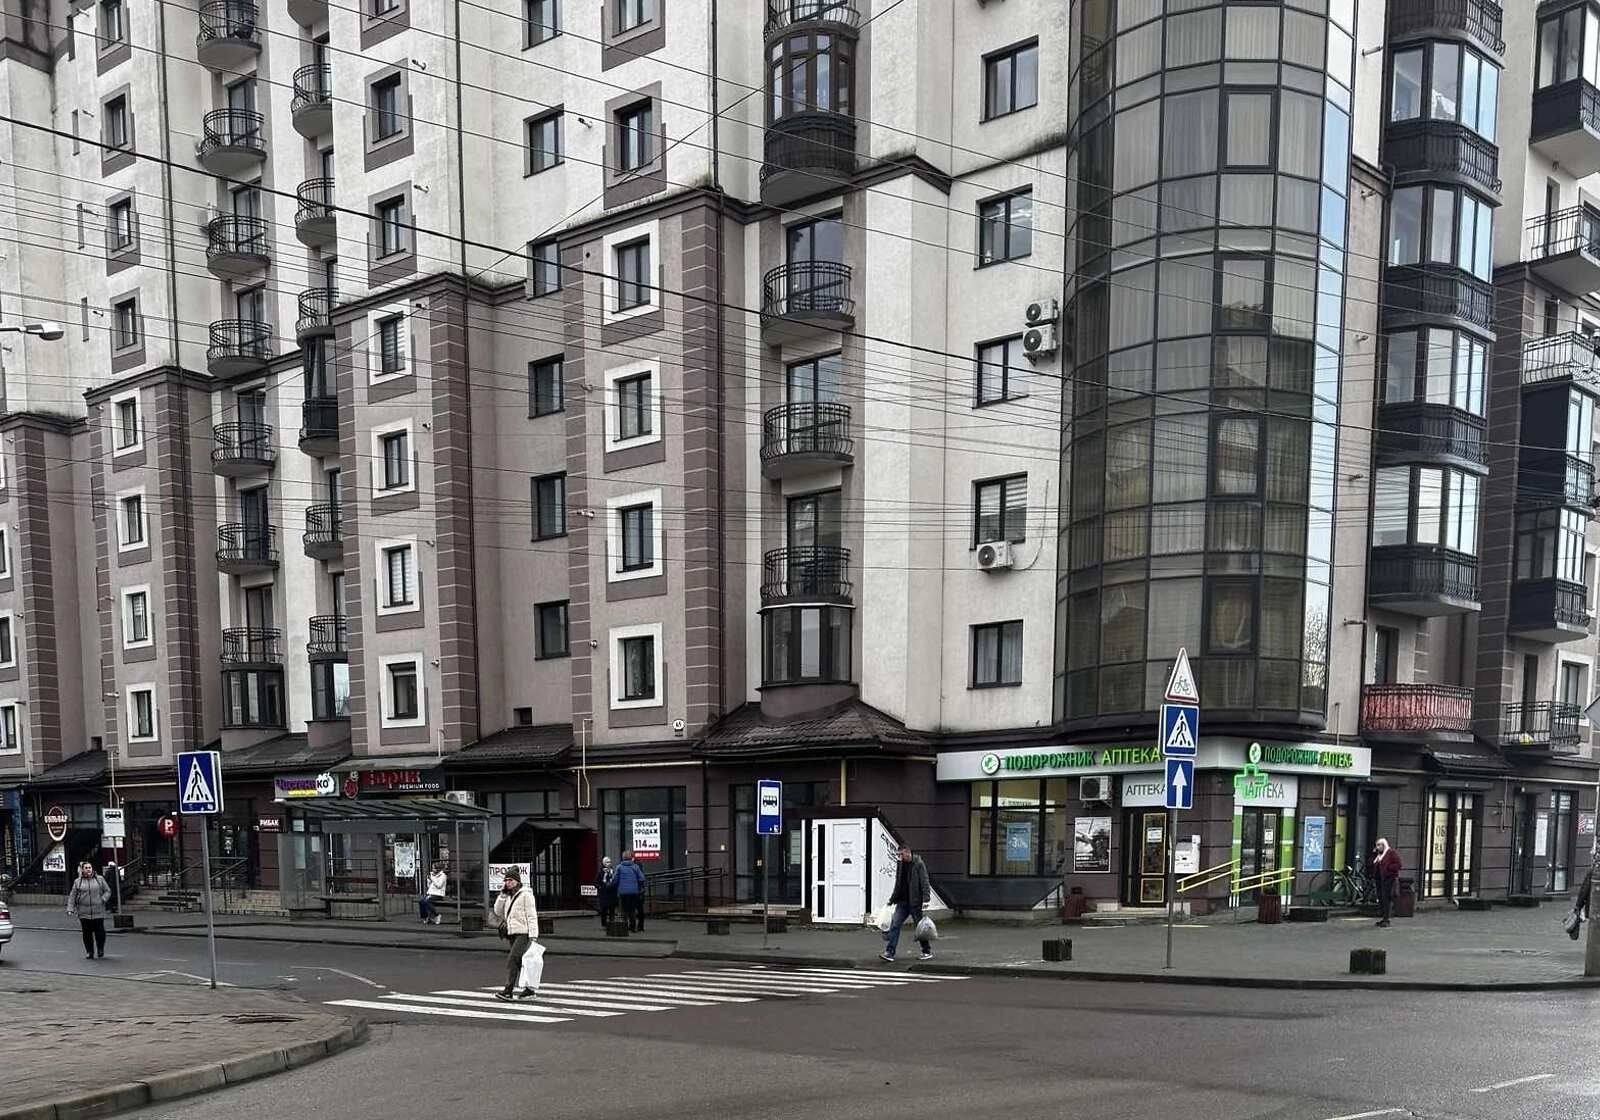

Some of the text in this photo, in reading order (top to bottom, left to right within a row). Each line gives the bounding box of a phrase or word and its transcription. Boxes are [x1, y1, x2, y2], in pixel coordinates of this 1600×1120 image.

[1005, 747, 1161, 770] ПОДОРОЖНИК АПТЕКА
[1265, 747, 1353, 768] ПОДОРОЖНИК АПТЕКА
[259, 819, 279, 827] РИБАК
[635, 839, 647, 848] 114
[489, 866, 528, 876] ПРОЖ
